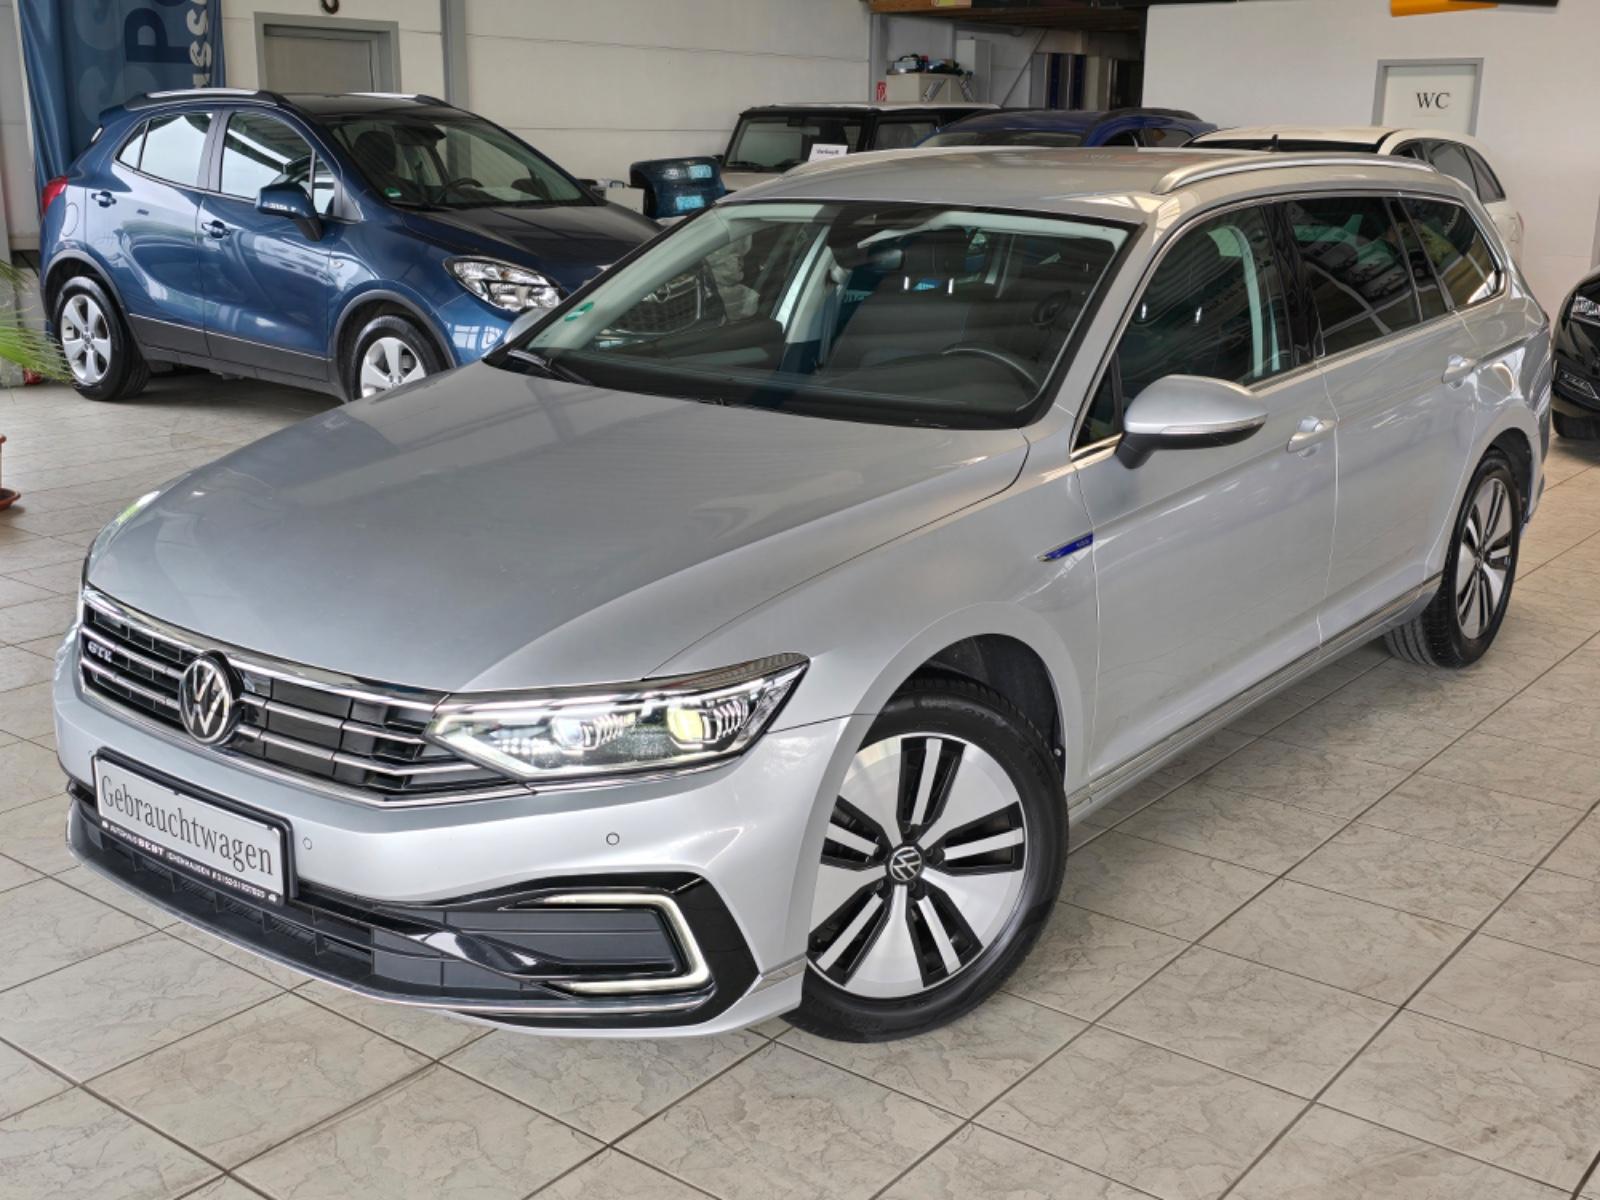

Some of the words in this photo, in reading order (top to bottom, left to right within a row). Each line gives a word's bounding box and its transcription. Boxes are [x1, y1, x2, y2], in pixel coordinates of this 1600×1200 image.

[1416, 92, 1451, 110] WC
[87, 640, 113, 663] GTE
[101, 775, 273, 876] Gebrauchtwagen
